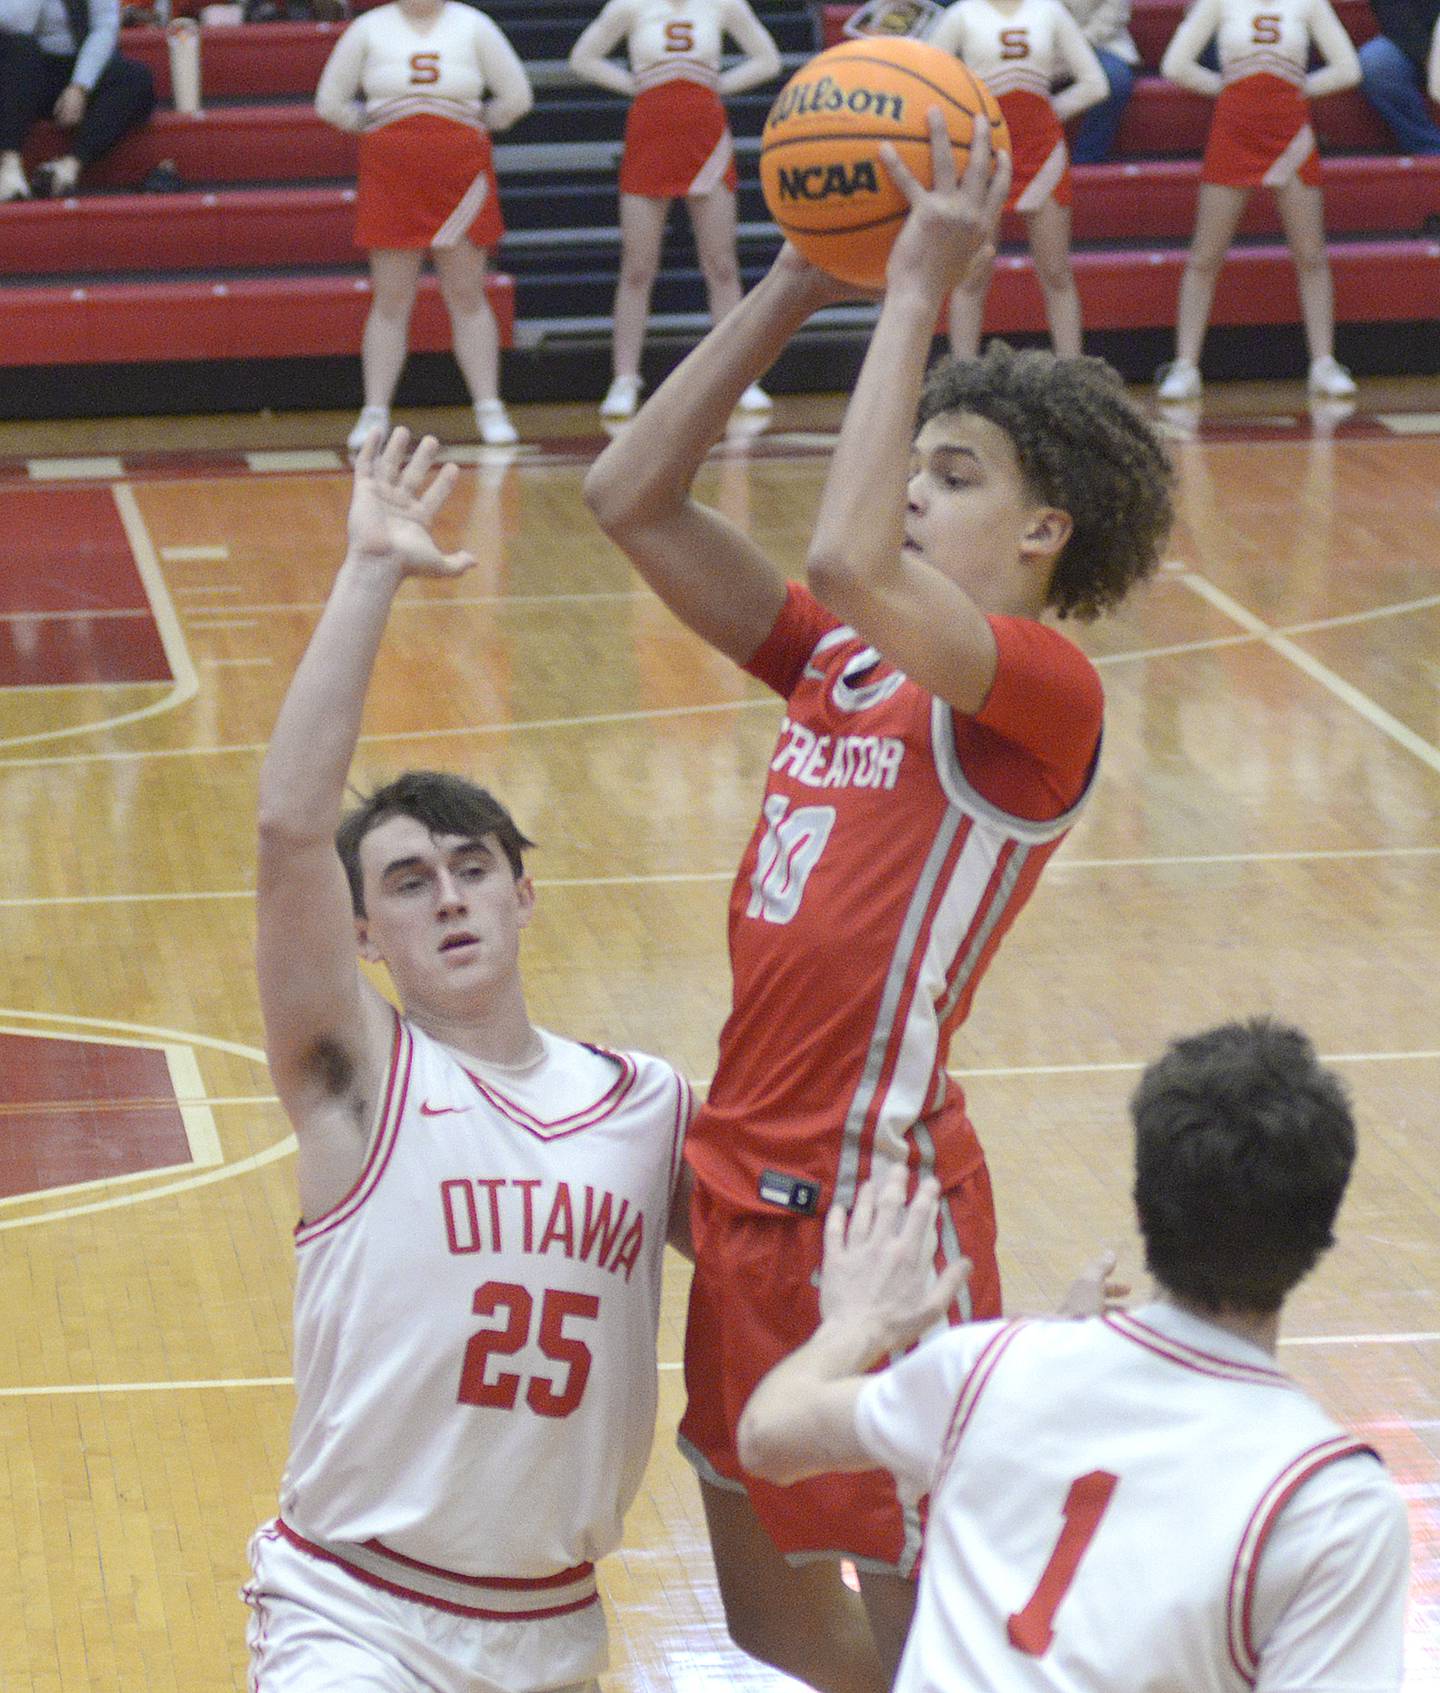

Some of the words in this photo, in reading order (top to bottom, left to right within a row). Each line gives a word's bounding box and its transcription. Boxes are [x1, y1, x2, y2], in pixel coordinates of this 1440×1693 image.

[664, 22, 693, 52] S
[1000, 29, 1029, 59] S
[1252, 15, 1281, 45] S
[408, 53, 439, 85] S
[777, 160, 878, 201] NCAA
[771, 716, 905, 790] REATOR
[746, 793, 836, 924] 10
[441, 1178, 644, 1284] OTTAWA
[456, 1280, 600, 1419] 25
[1007, 1470, 1119, 1659] 1
